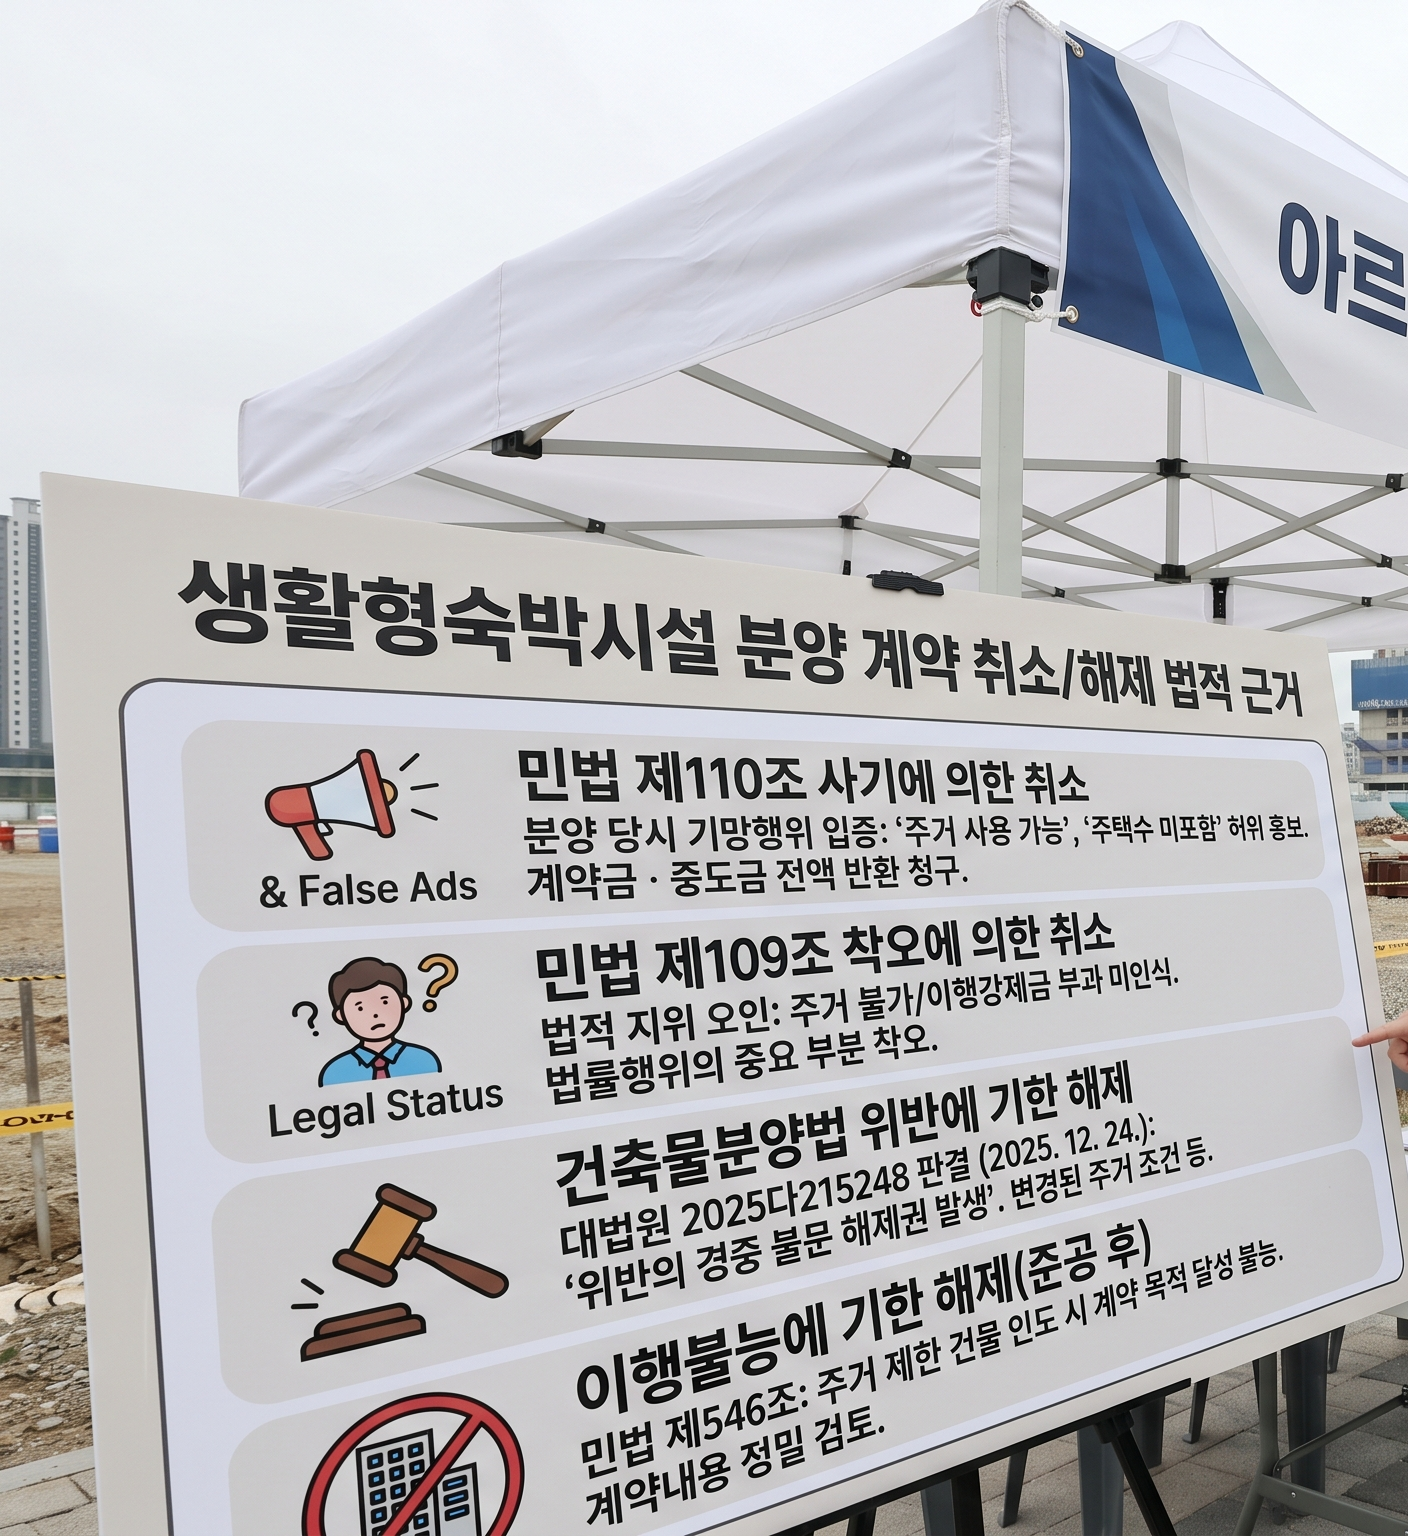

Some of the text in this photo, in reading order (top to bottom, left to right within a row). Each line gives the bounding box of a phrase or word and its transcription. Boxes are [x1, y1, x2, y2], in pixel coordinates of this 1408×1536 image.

[177, 559, 1303, 718] 생활형숙박시설 분양 계약 취소/해제 법적 근거
[518, 747, 1090, 805] 민법 제110조 사기에 의한 취소
[523, 816, 598, 855] 분양
[608, 815, 676, 854] 당시
[688, 815, 813, 852] 기망행위
[822, 815, 888, 850] 입증:
[895, 815, 956, 848] ‘주거
[964, 815, 1012, 847] 사용
[1159, 814, 1221, 843] 미포함’
[1227, 814, 1265, 842] 허위
[1268, 813, 1309, 841] 홍보.
[527, 862, 637, 903] 계약금
[670, 859, 767, 897] 중도금
[776, 856, 836, 893] 전액
[844, 855, 900, 890] 반환
[907, 854, 968, 887] 청구.
[259, 870, 478, 909] & False Ads
[536, 911, 1116, 1003] 민법 제109조 착오에 의한 취소
[541, 956, 1179, 1057] 법적 지위 오인: 주거 불가/이행강제금 부과 미인식.
[268, 1084, 504, 1139] Legal Status
[545, 1024, 938, 1106] 법률행위의 중요 부분 착오.
[556, 1059, 1133, 1208] 건축물분양법 위반에 기한 해제
[560, 1204, 672, 1259] 대법원
[681, 1162, 910, 1237] 2025다215248
[916, 1146, 971, 1190] 판결
[979, 1133, 1059, 1180] (2025.
[1064, 1125, 1099, 1156] 12.
[565, 1250, 686, 1311] ‘위반의
[696, 1234, 763, 1283] 경중
[770, 1219, 833, 1267] 불문
[840, 1197, 929, 1247] 해제권
[1010, 1163, 1083, 1211] 변경된
[1089, 1152, 1133, 1191] 주거
[1138, 1141, 1181, 1178] 조건
[1186, 1136, 1213, 1168] 등.
[576, 1218, 1151, 1415] 이행불능에 기한 해제(준공 후)
[580, 1239, 1284, 1480] 민법 제546조: 주거 제한 건물 인도 시 계약 목적 달성 불능.
[585, 1405, 885, 1526] 계약내용 정밀 검토.
